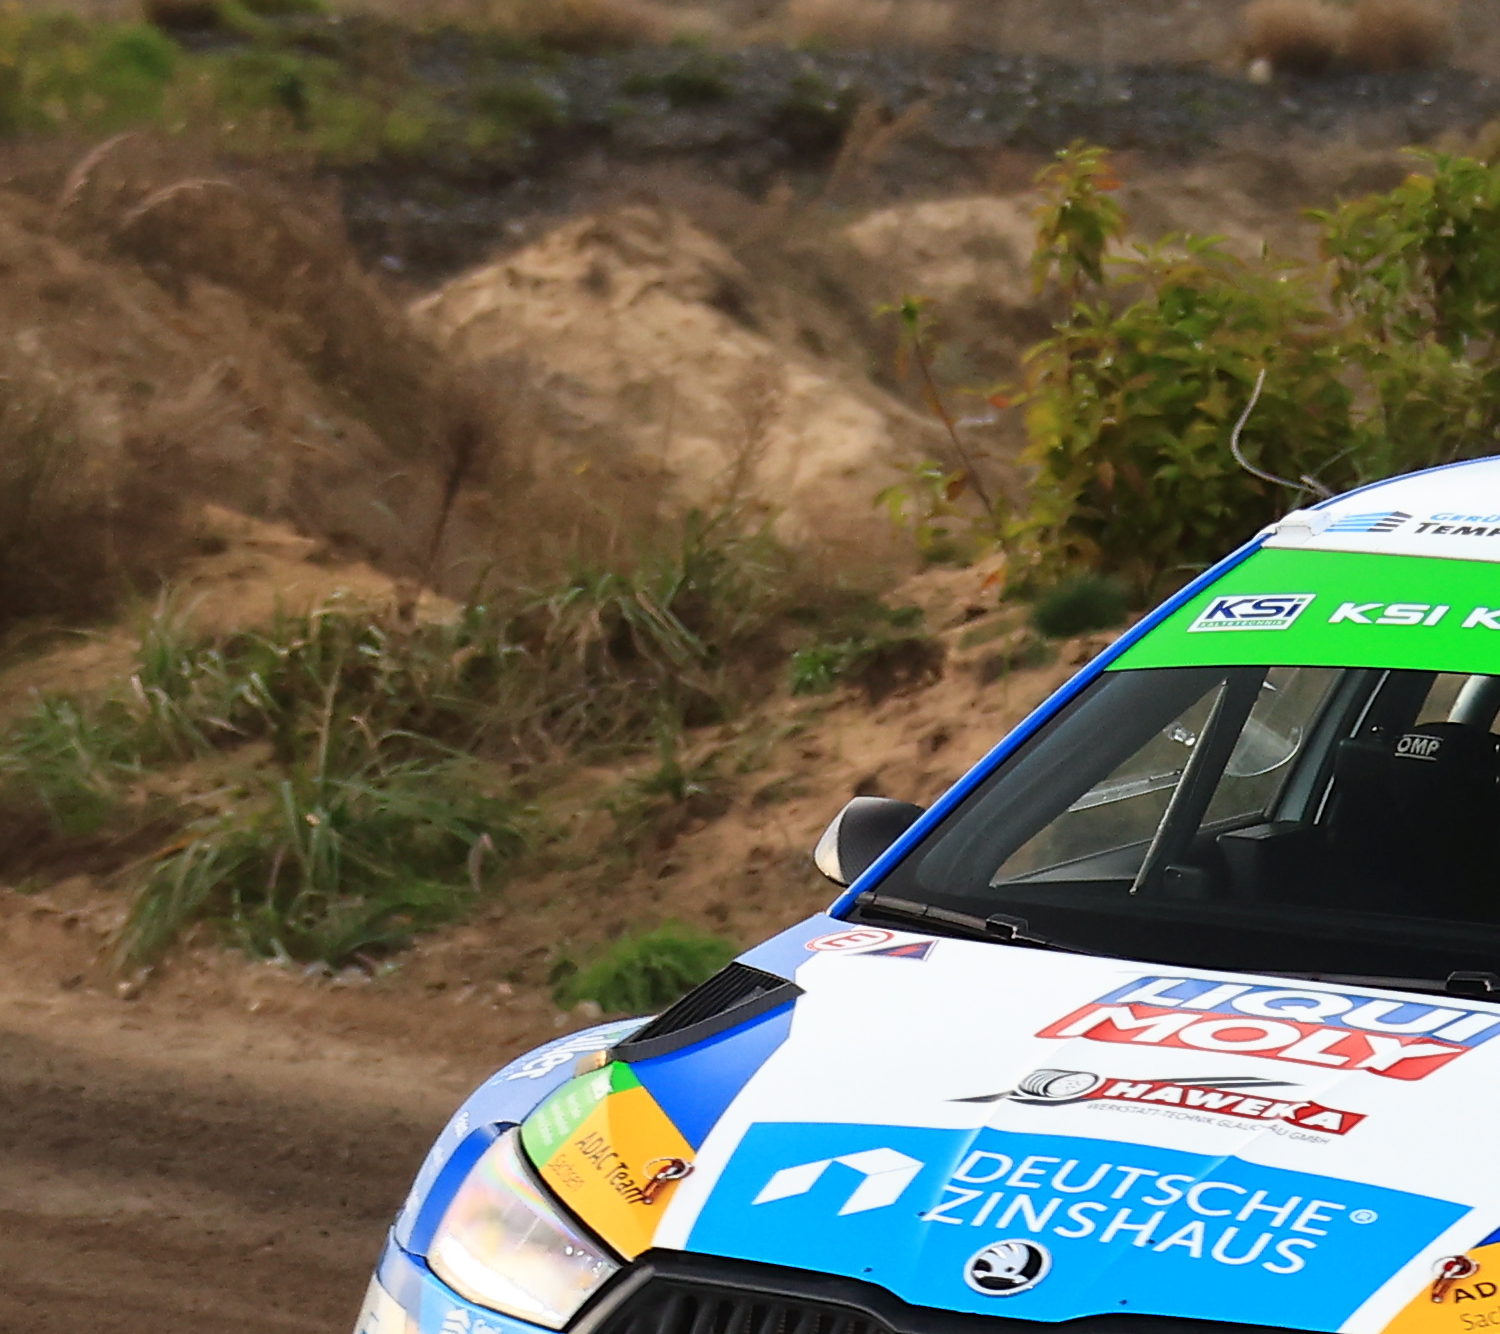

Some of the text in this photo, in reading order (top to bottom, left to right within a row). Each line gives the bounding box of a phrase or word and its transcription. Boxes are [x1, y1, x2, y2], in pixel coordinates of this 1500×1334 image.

[1328, 602, 1451, 627] KSI
[1396, 737, 1441, 757] OMP
[1071, 1003, 1465, 1072] MOLY
[1102, 1081, 1345, 1131] HAWEKA
[951, 1149, 1345, 1238] DEUTSCHE
[921, 1187, 1318, 1275] ZINSHAUS
